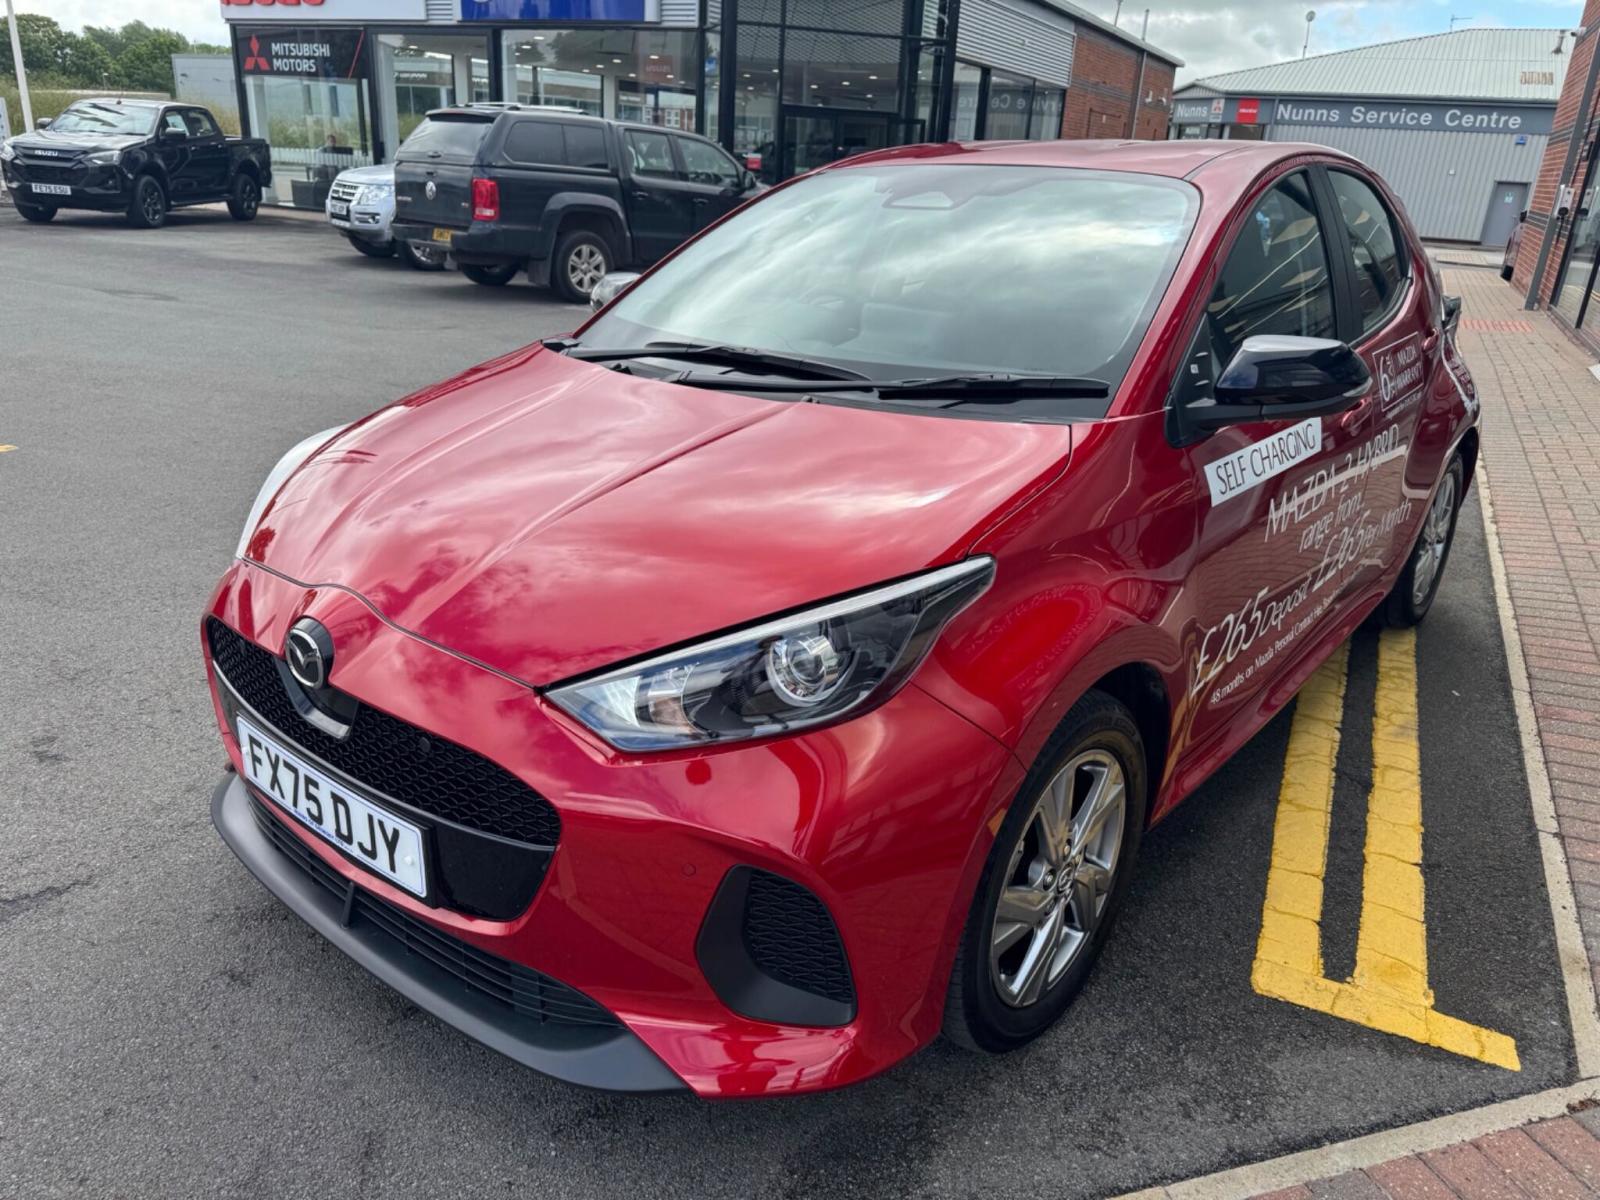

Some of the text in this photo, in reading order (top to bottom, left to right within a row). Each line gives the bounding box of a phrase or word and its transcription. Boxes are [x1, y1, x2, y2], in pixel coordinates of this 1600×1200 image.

[271, 42, 330, 57] MITSUBISHI
[273, 58, 316, 73] MOTORS
[1177, 103, 1208, 118] Nunns
[1276, 103, 1522, 129] Nunns Service Centre
[1215, 423, 1316, 495] SELF CHARGING
[1265, 463, 1336, 543] MAZDA
[1354, 423, 1400, 484] HYBRID
[1299, 511, 1335, 553] range
[1190, 586, 1270, 698] £265
[1221, 672, 1245, 699] months
[1245, 665, 1254, 679] on
[1254, 646, 1274, 671] Mazda
[247, 733, 400, 874] FX75 DJY
